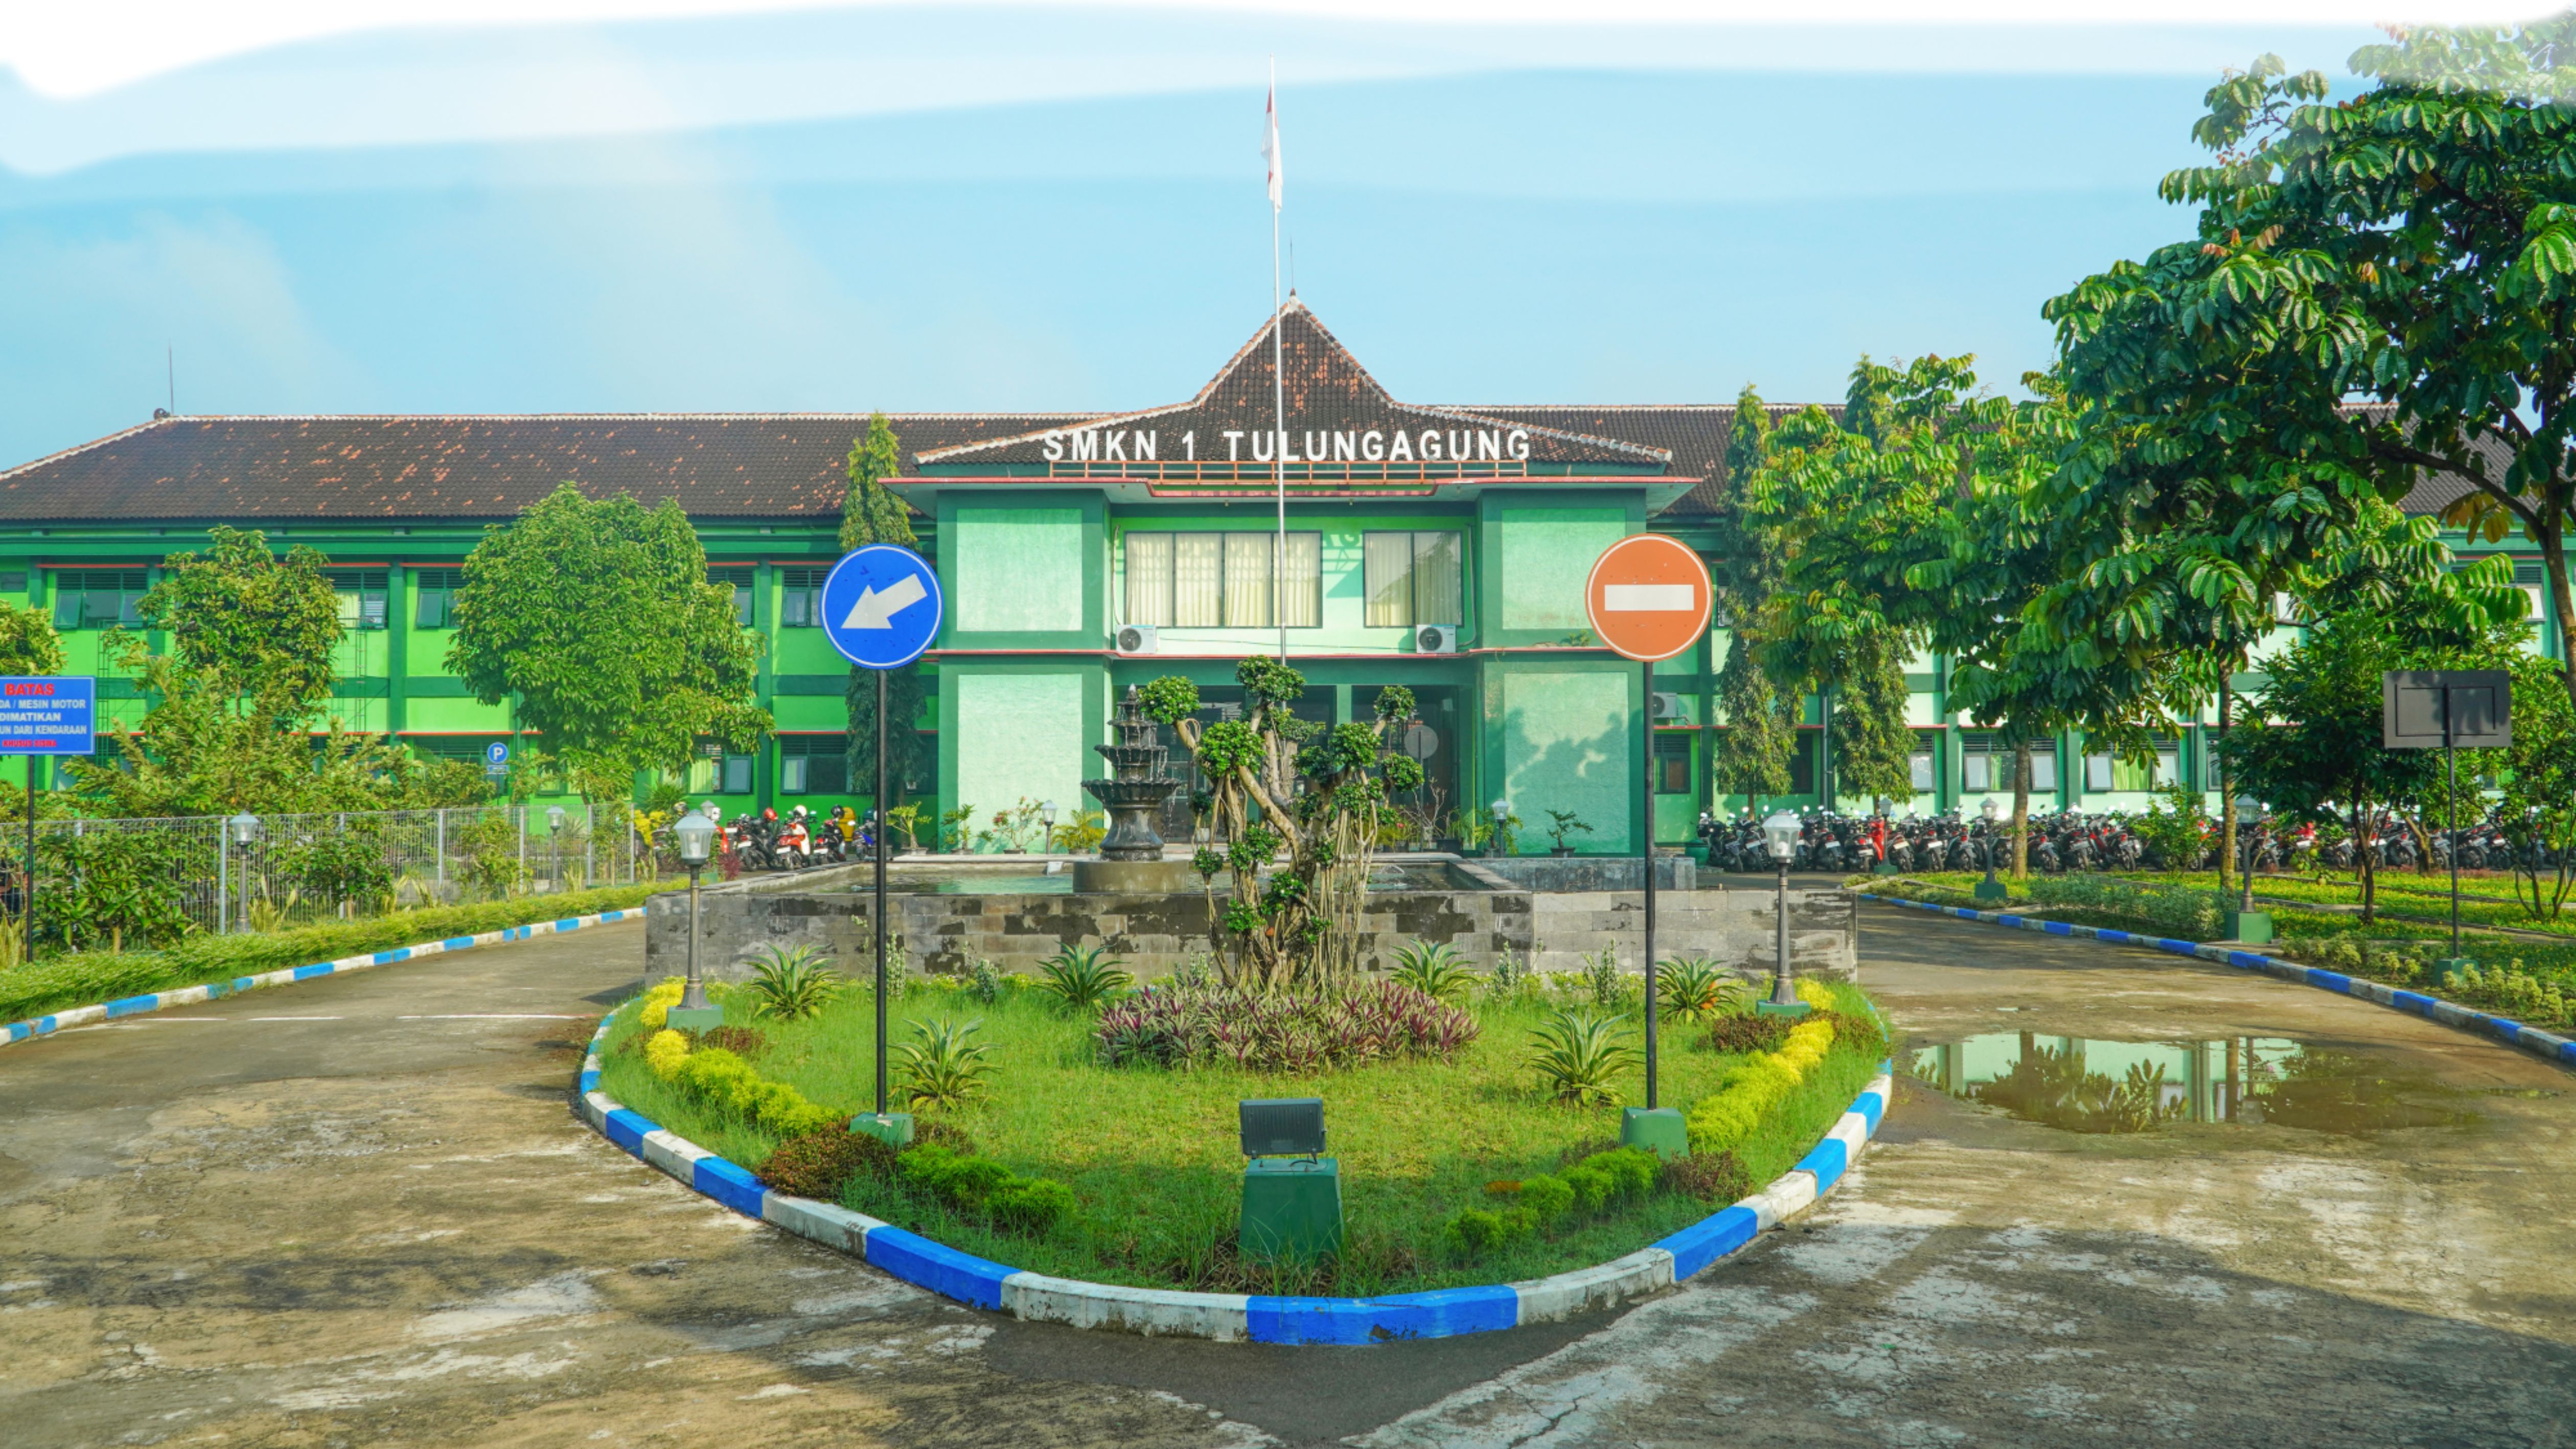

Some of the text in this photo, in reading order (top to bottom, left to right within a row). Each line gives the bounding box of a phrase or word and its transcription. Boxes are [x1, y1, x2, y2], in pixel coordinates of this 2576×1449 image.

[1043, 429, 1530, 462] SMKN 1 TULUNGAGUNG
[5, 683, 55, 696] BATAS
[18, 699, 49, 709] MESIN
[51, 699, 86, 709] MOTOR
[0, 712, 61, 722] DIMATIKAN
[13, 725, 33, 734] DARI
[35, 725, 87, 734] KENDARAAN
[493, 747, 503, 761] P
